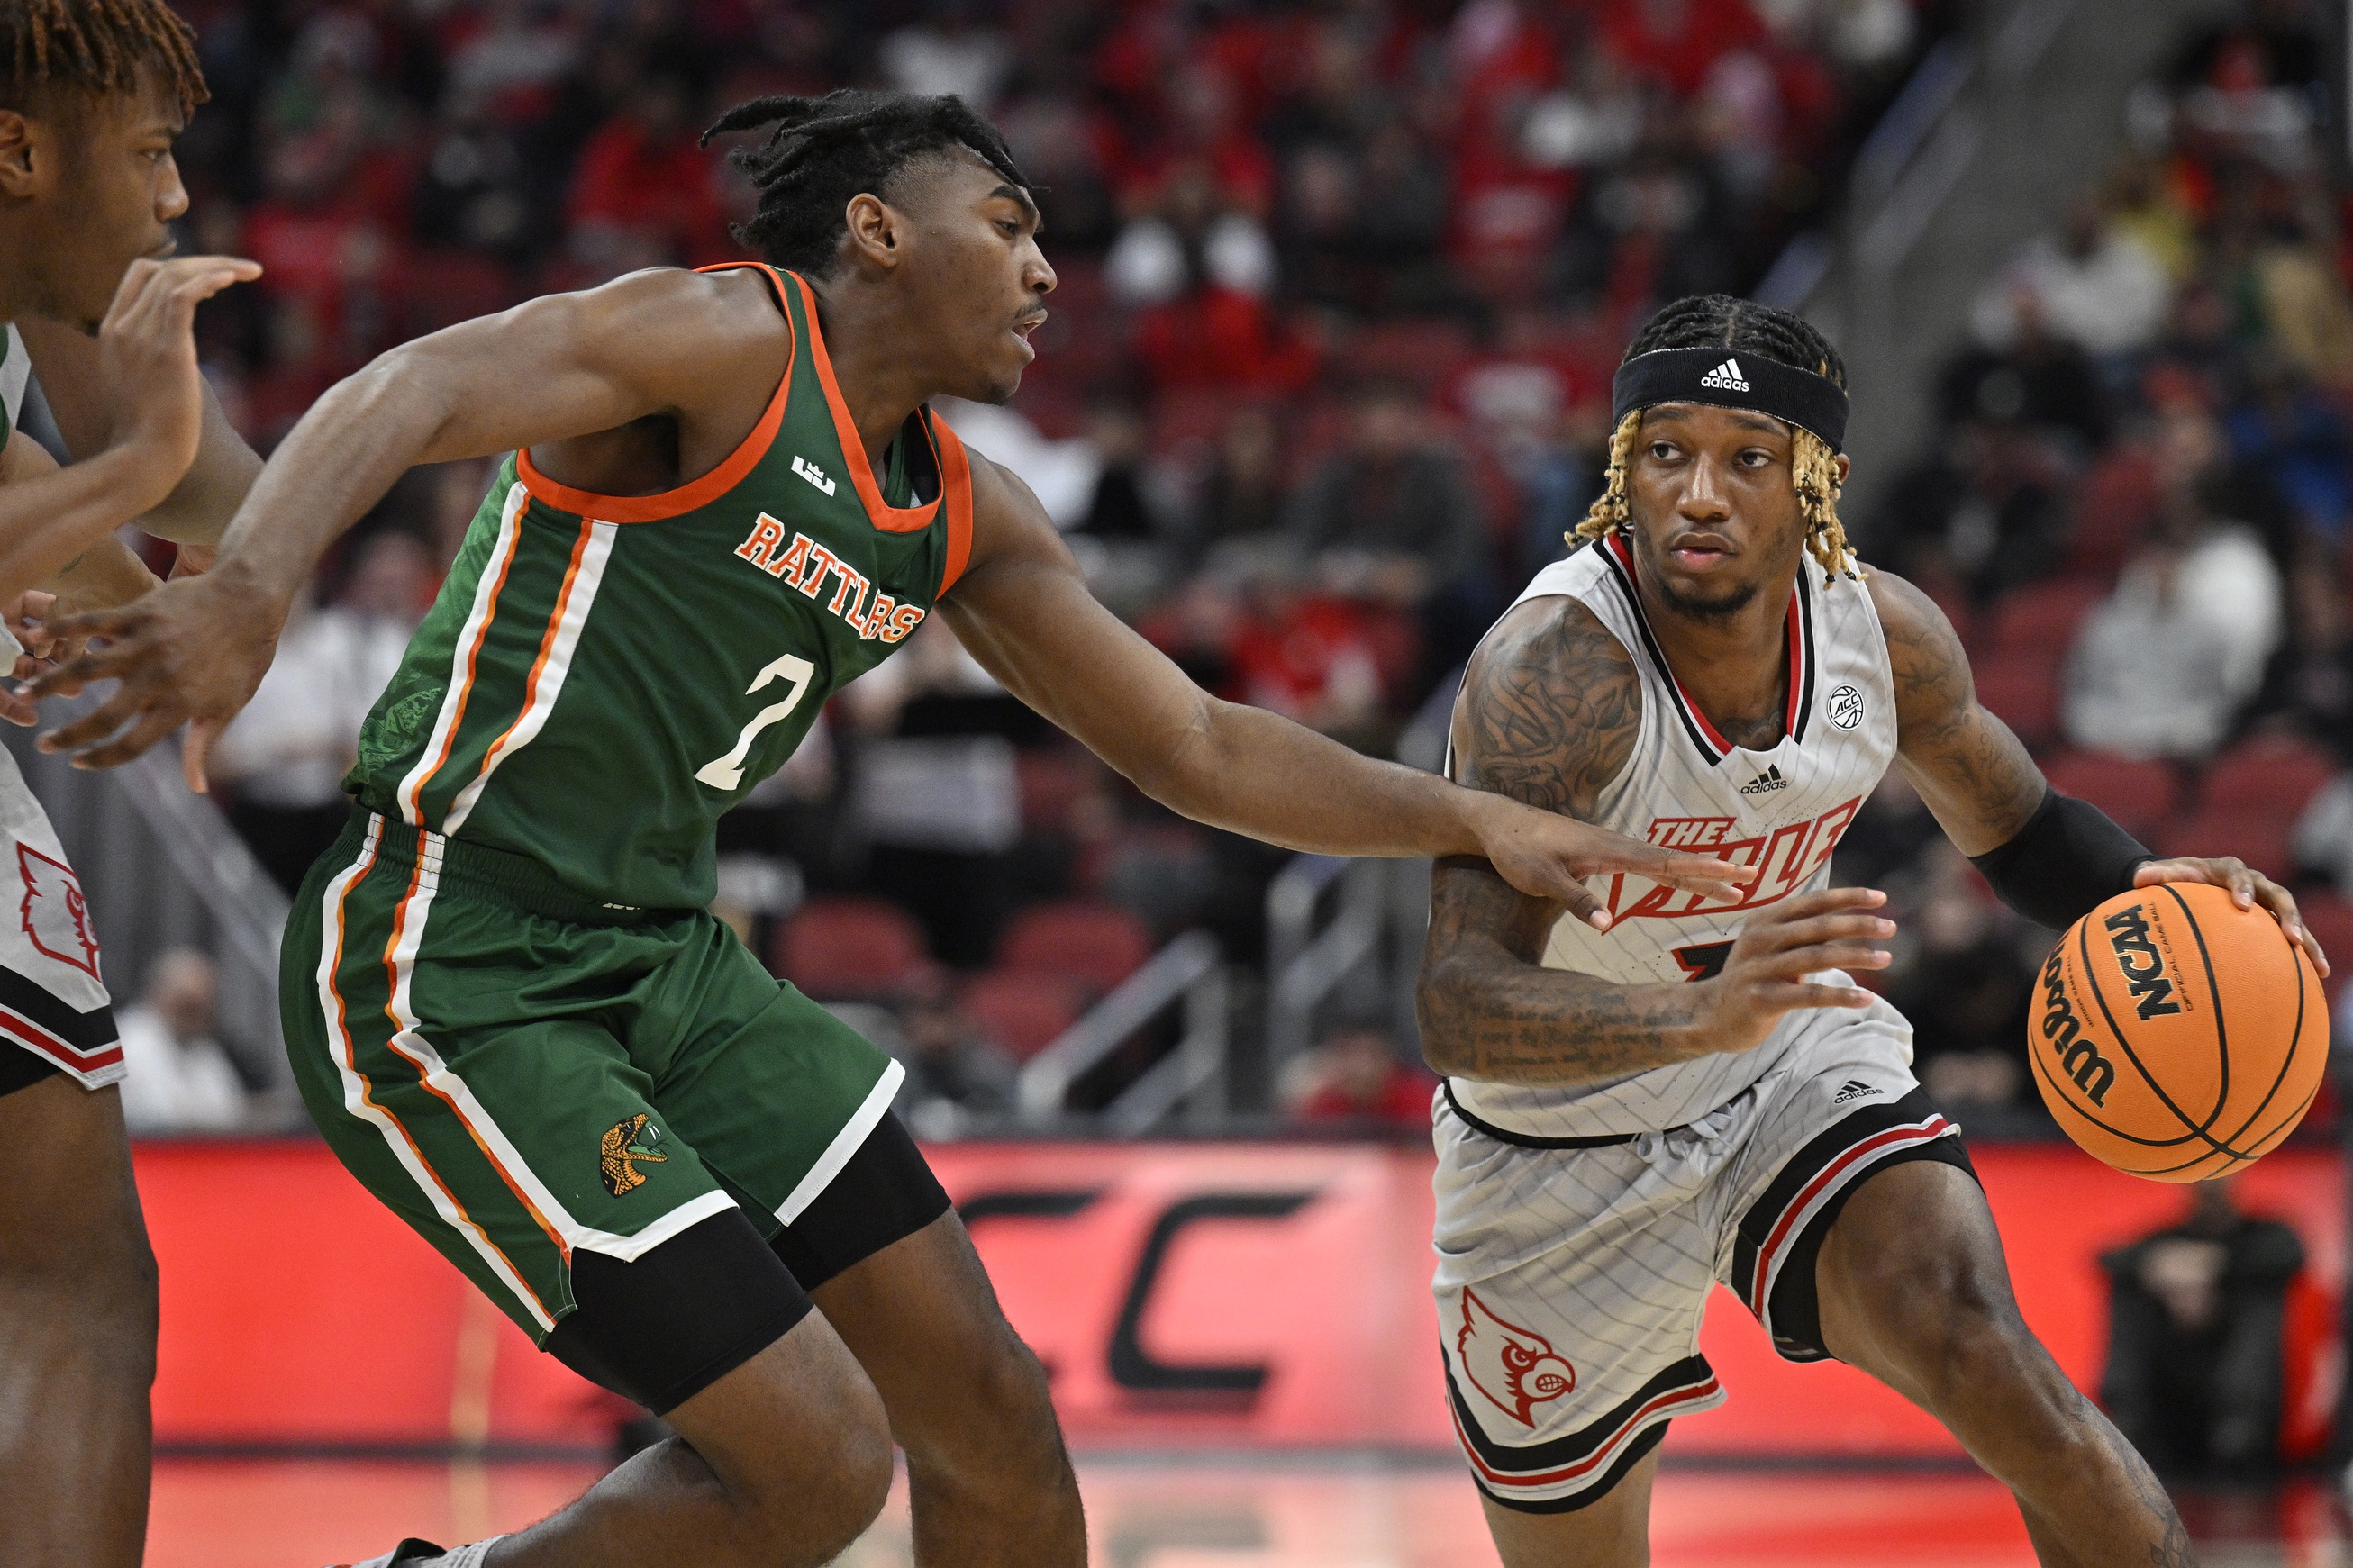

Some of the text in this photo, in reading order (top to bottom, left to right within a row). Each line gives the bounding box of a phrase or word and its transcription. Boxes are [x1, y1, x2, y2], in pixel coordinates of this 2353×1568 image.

[1701, 374, 1749, 392] adidas
[734, 512, 925, 644] RATTLRS
[1834, 693, 1859, 716] ACC
[694, 654, 814, 791] 2
[1740, 776, 1787, 794] adidas
[1650, 819, 1735, 847] THE
[2156, 922, 2173, 955] GAME
[2104, 903, 2183, 1020] NCAA
[2169, 956, 2194, 1011] OFFICIAL
[2042, 927, 2115, 1109] Wilson
[1833, 1088, 1885, 1104] adidas
